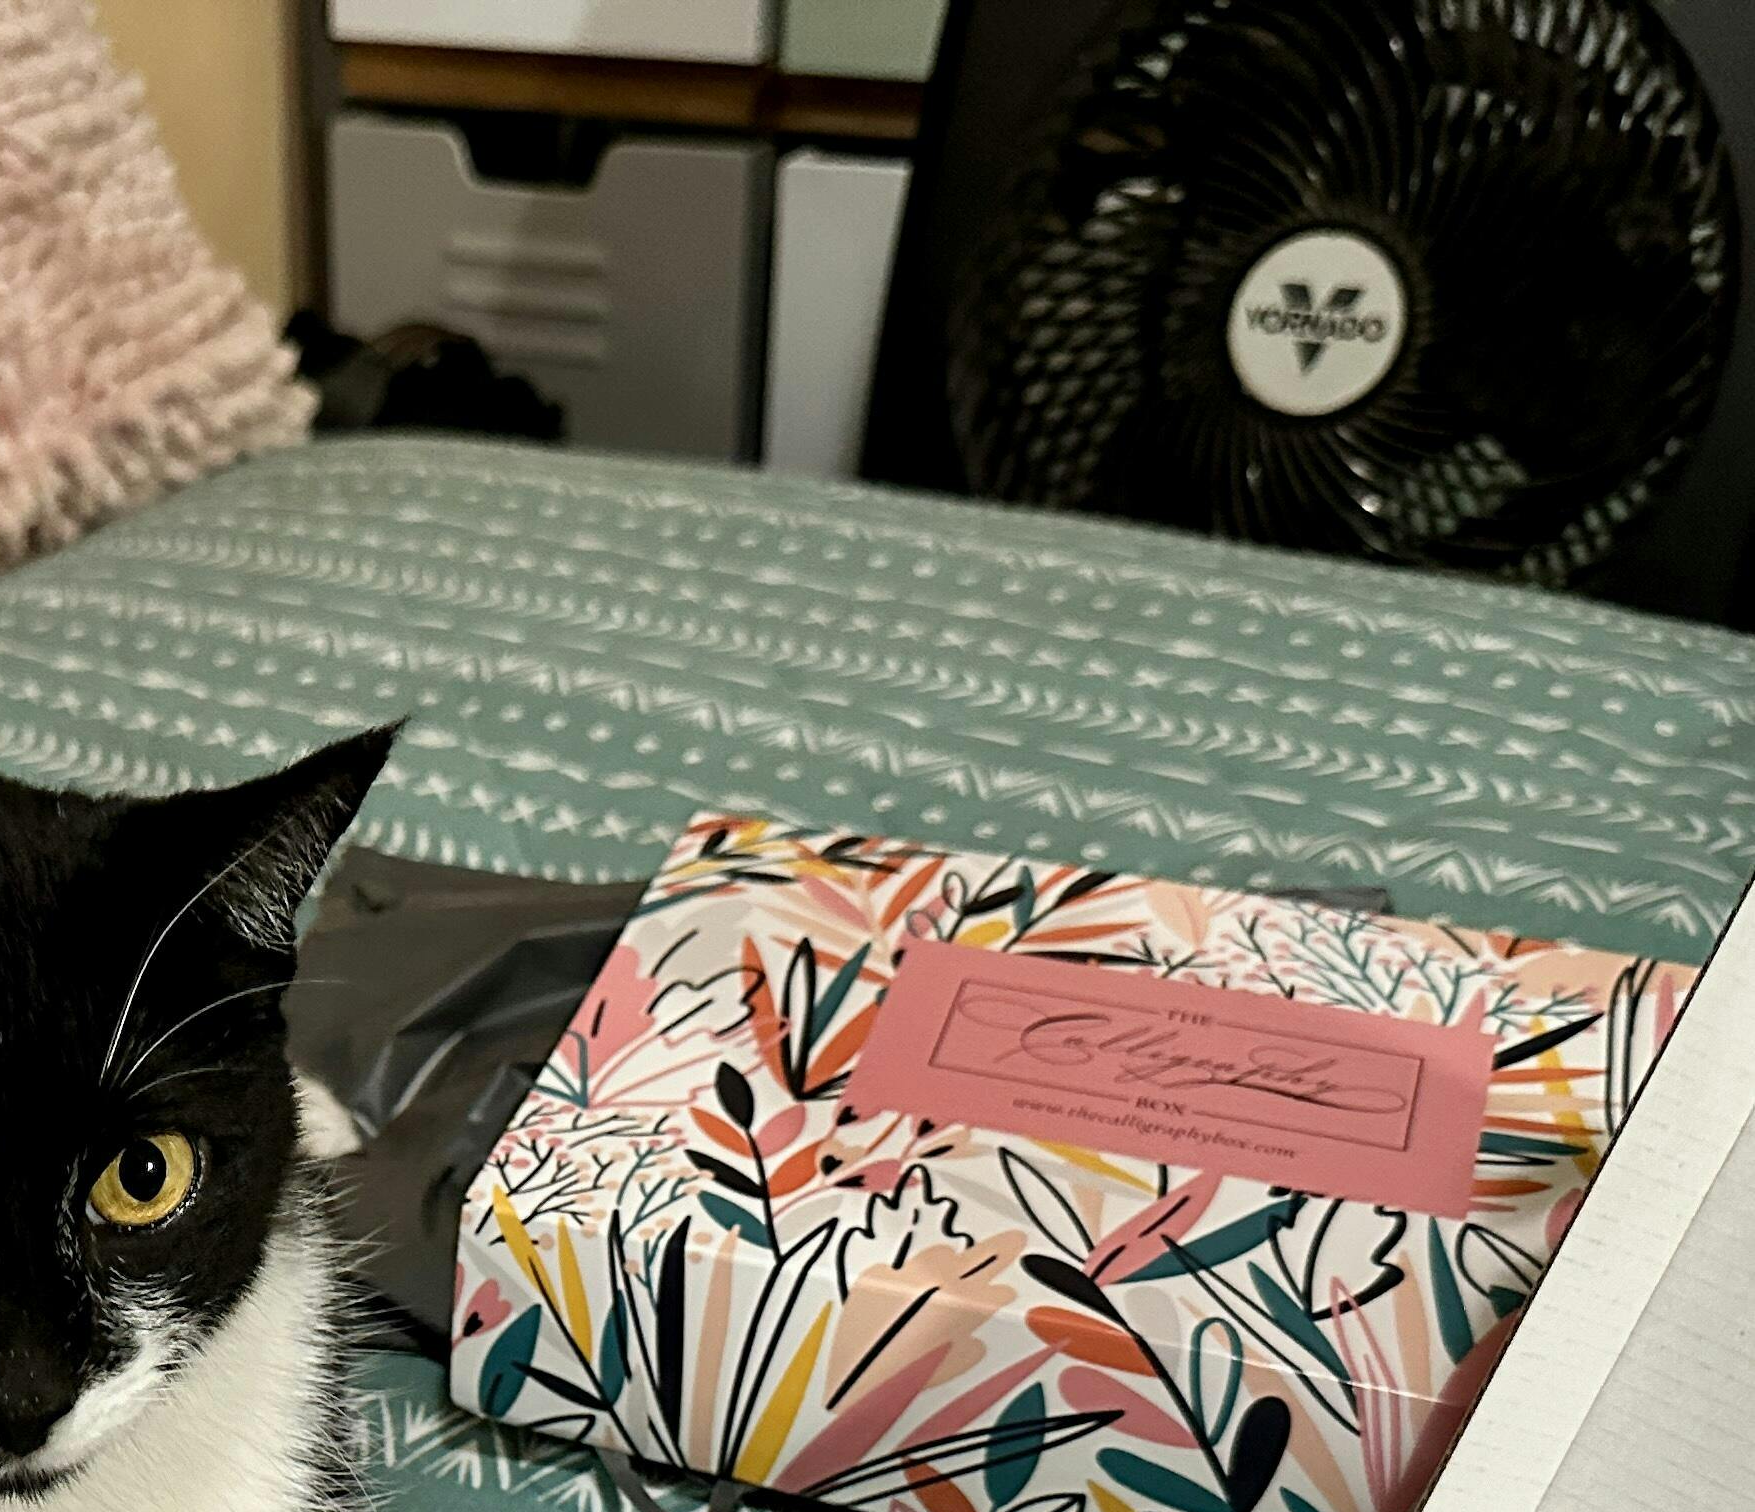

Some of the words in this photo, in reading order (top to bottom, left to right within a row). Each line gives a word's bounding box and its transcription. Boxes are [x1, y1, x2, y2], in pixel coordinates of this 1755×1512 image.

[1247, 306, 1387, 343] VORNADO
[1165, 1009, 1213, 1027] THE
[1134, 1095, 1187, 1117] BOX
[1011, 1098, 1297, 1159] www.thecalligraphybox.com
